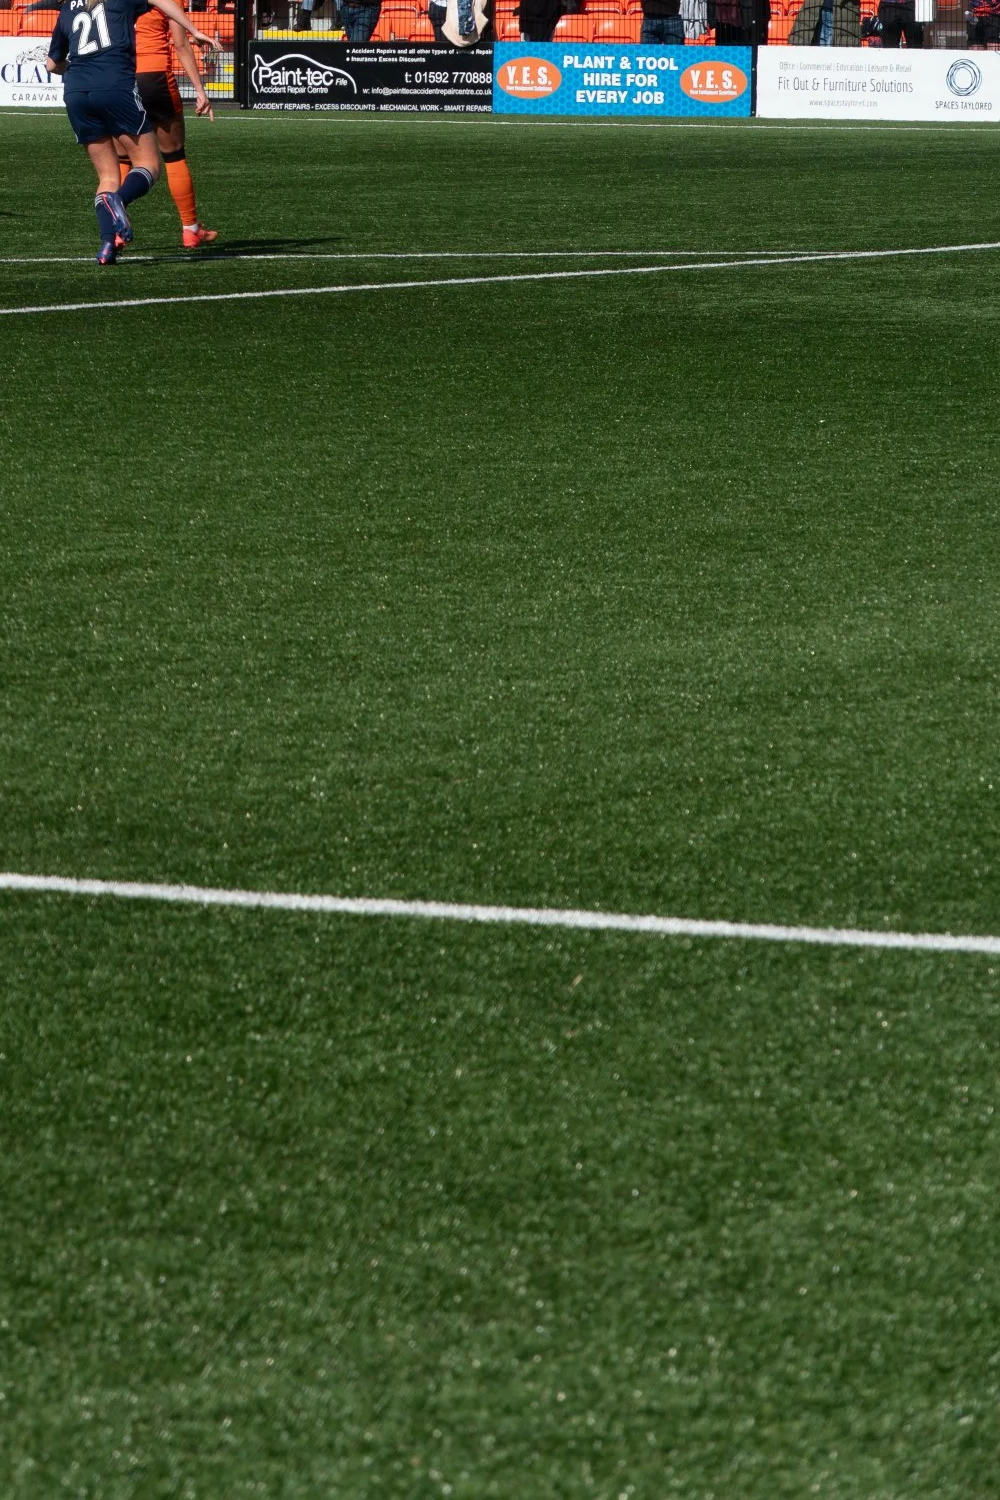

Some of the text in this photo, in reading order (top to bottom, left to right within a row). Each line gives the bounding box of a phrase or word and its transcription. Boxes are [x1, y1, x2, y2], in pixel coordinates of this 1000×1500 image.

[72, 3, 112, 56] 21
[563, 55, 678, 70] PLANT & TOOL
[258, 66, 334, 86] Paint-tec
[415, 72, 449, 83] 01592
[452, 72, 492, 84] 770888
[583, 72, 658, 87] HIRE FOR
[287, 86, 306, 94] Repair
[778, 76, 913, 92] Fit Out & Furniture Solutions
[12, 93, 58, 101] CARAVAN
[576, 90, 664, 104] EVERY JOB
[935, 101, 992, 110] SPACES TAYLORED
